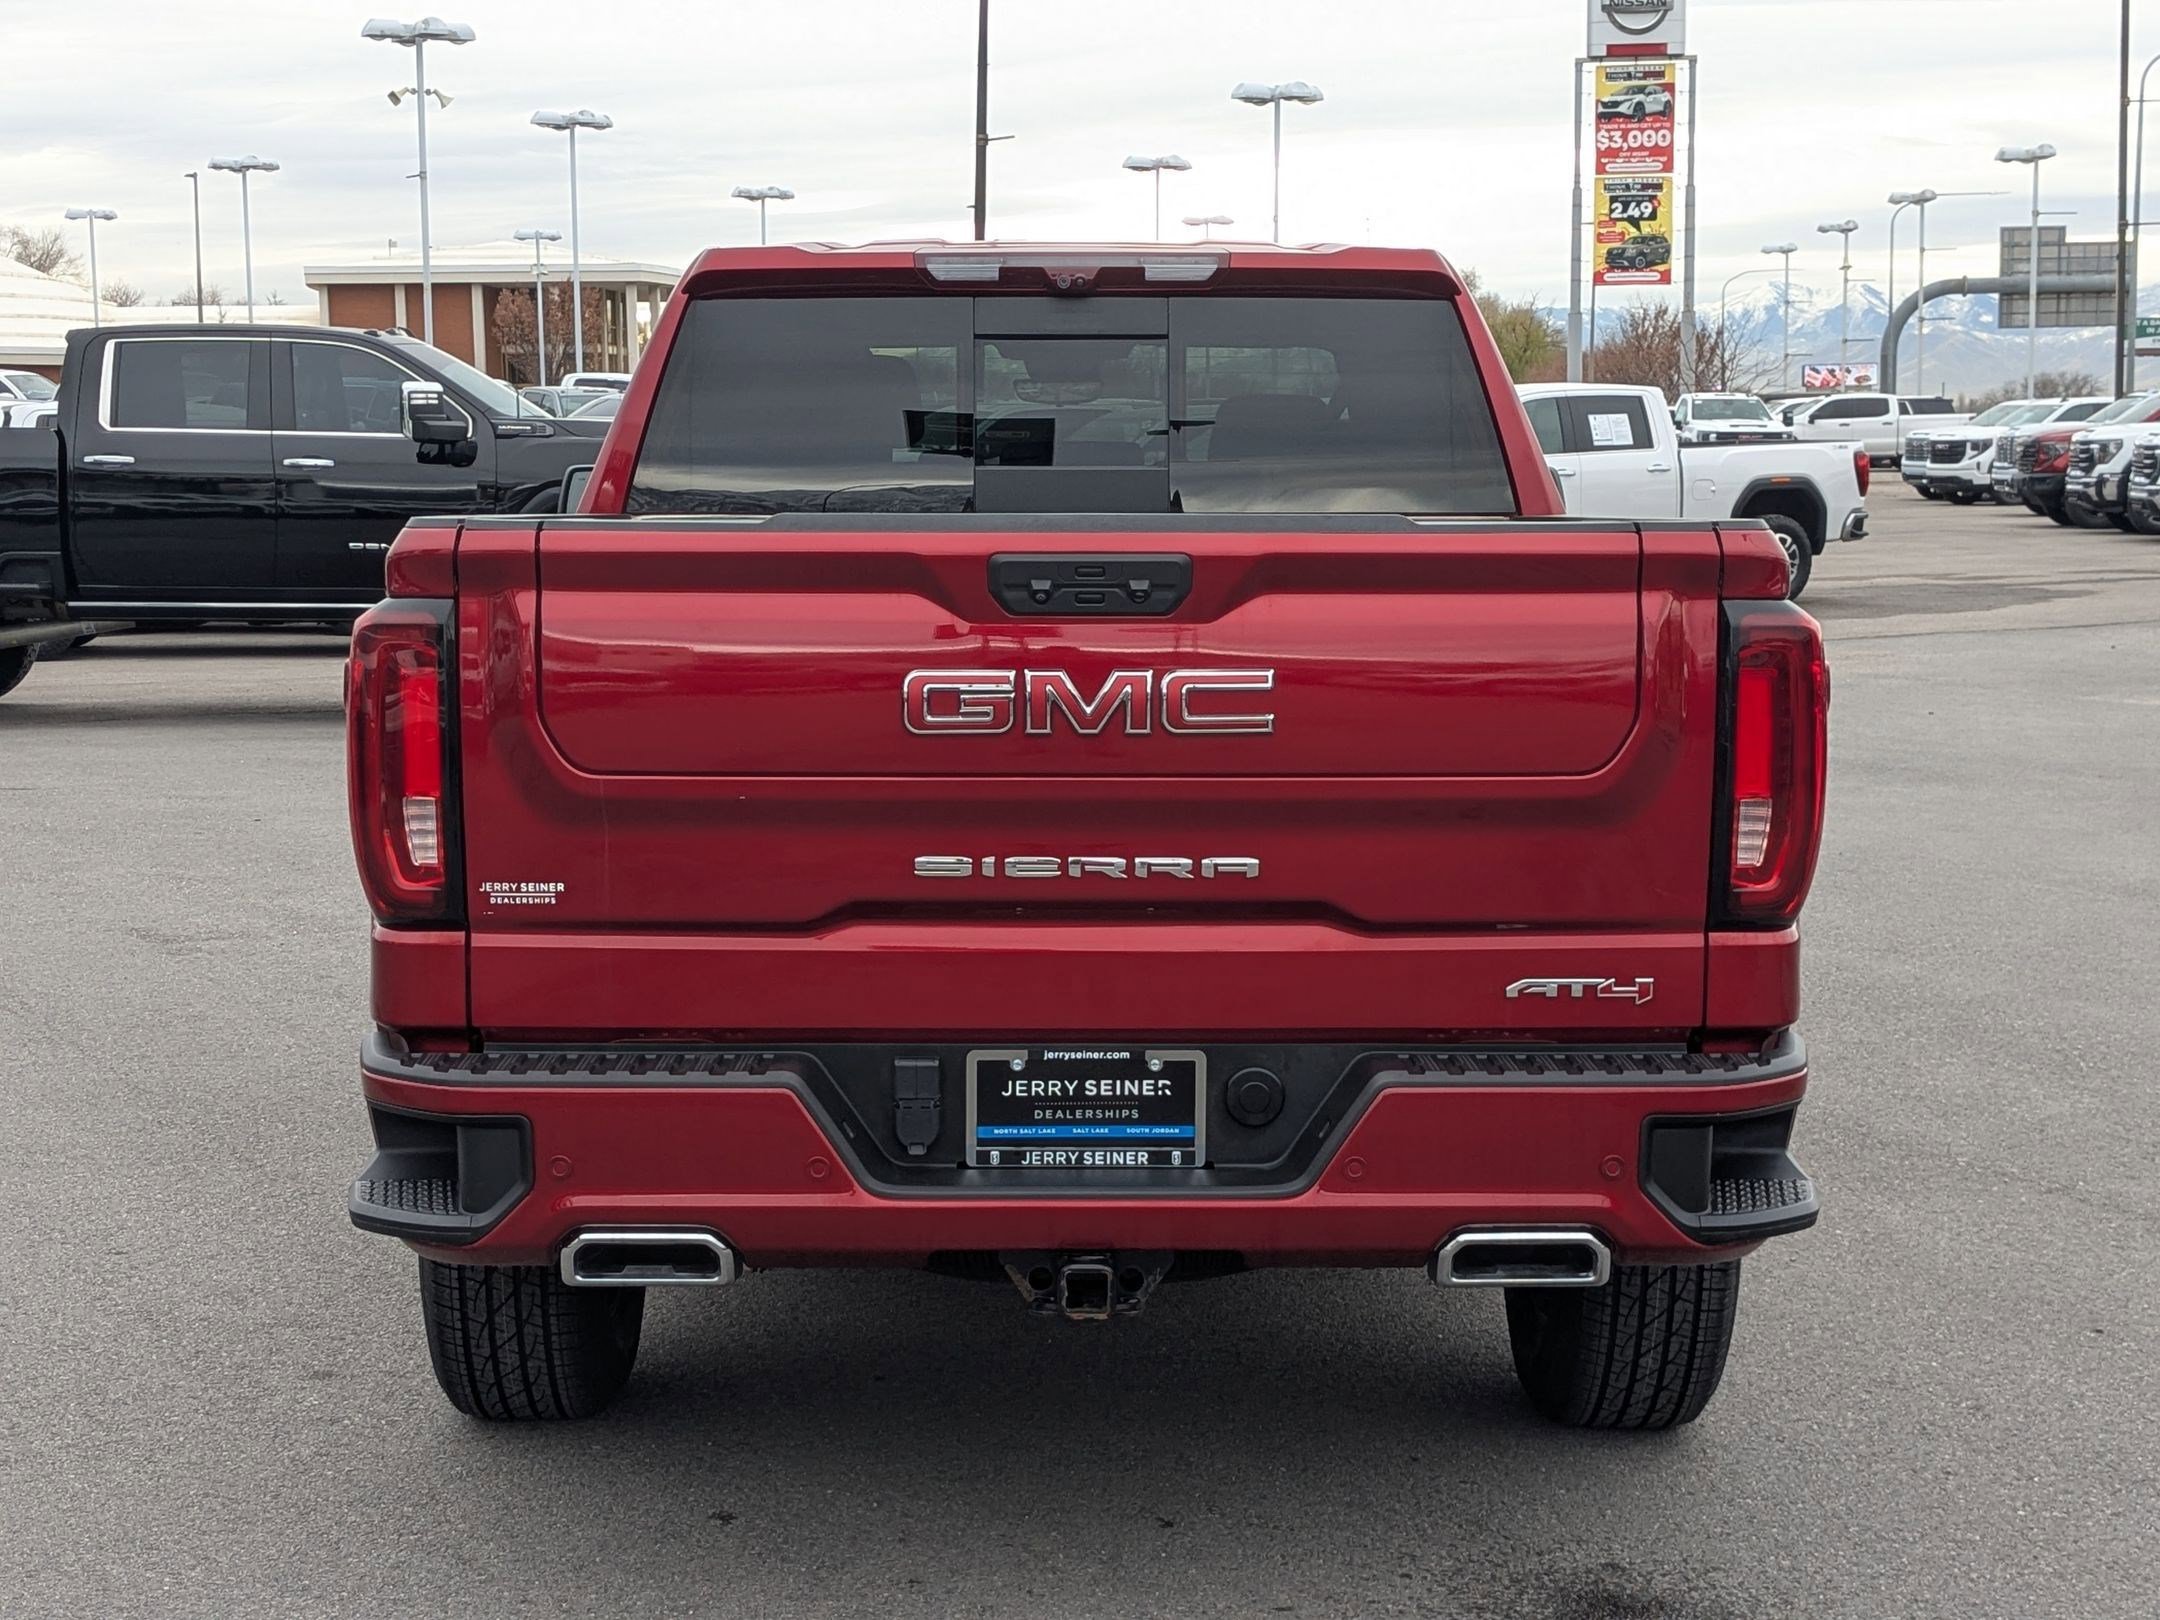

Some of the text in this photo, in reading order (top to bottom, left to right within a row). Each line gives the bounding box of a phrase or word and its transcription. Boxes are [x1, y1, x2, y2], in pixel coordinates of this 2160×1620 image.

[1596, 129, 1672, 151] $3,000
[1610, 201, 1653, 218] 2.49
[903, 669, 1275, 735] GMC
[914, 855, 1260, 879] SIERRA
[479, 882, 565, 892] JERRY SEINER
[1506, 978, 1654, 1005] AT4
[1044, 1050, 1130, 1060] jerryseiner.com
[1001, 1079, 1172, 1097] JERRY SEINER
[1034, 1109, 1140, 1120] DEALERSHIPS
[1021, 1151, 1149, 1165] JERRY SEINER
